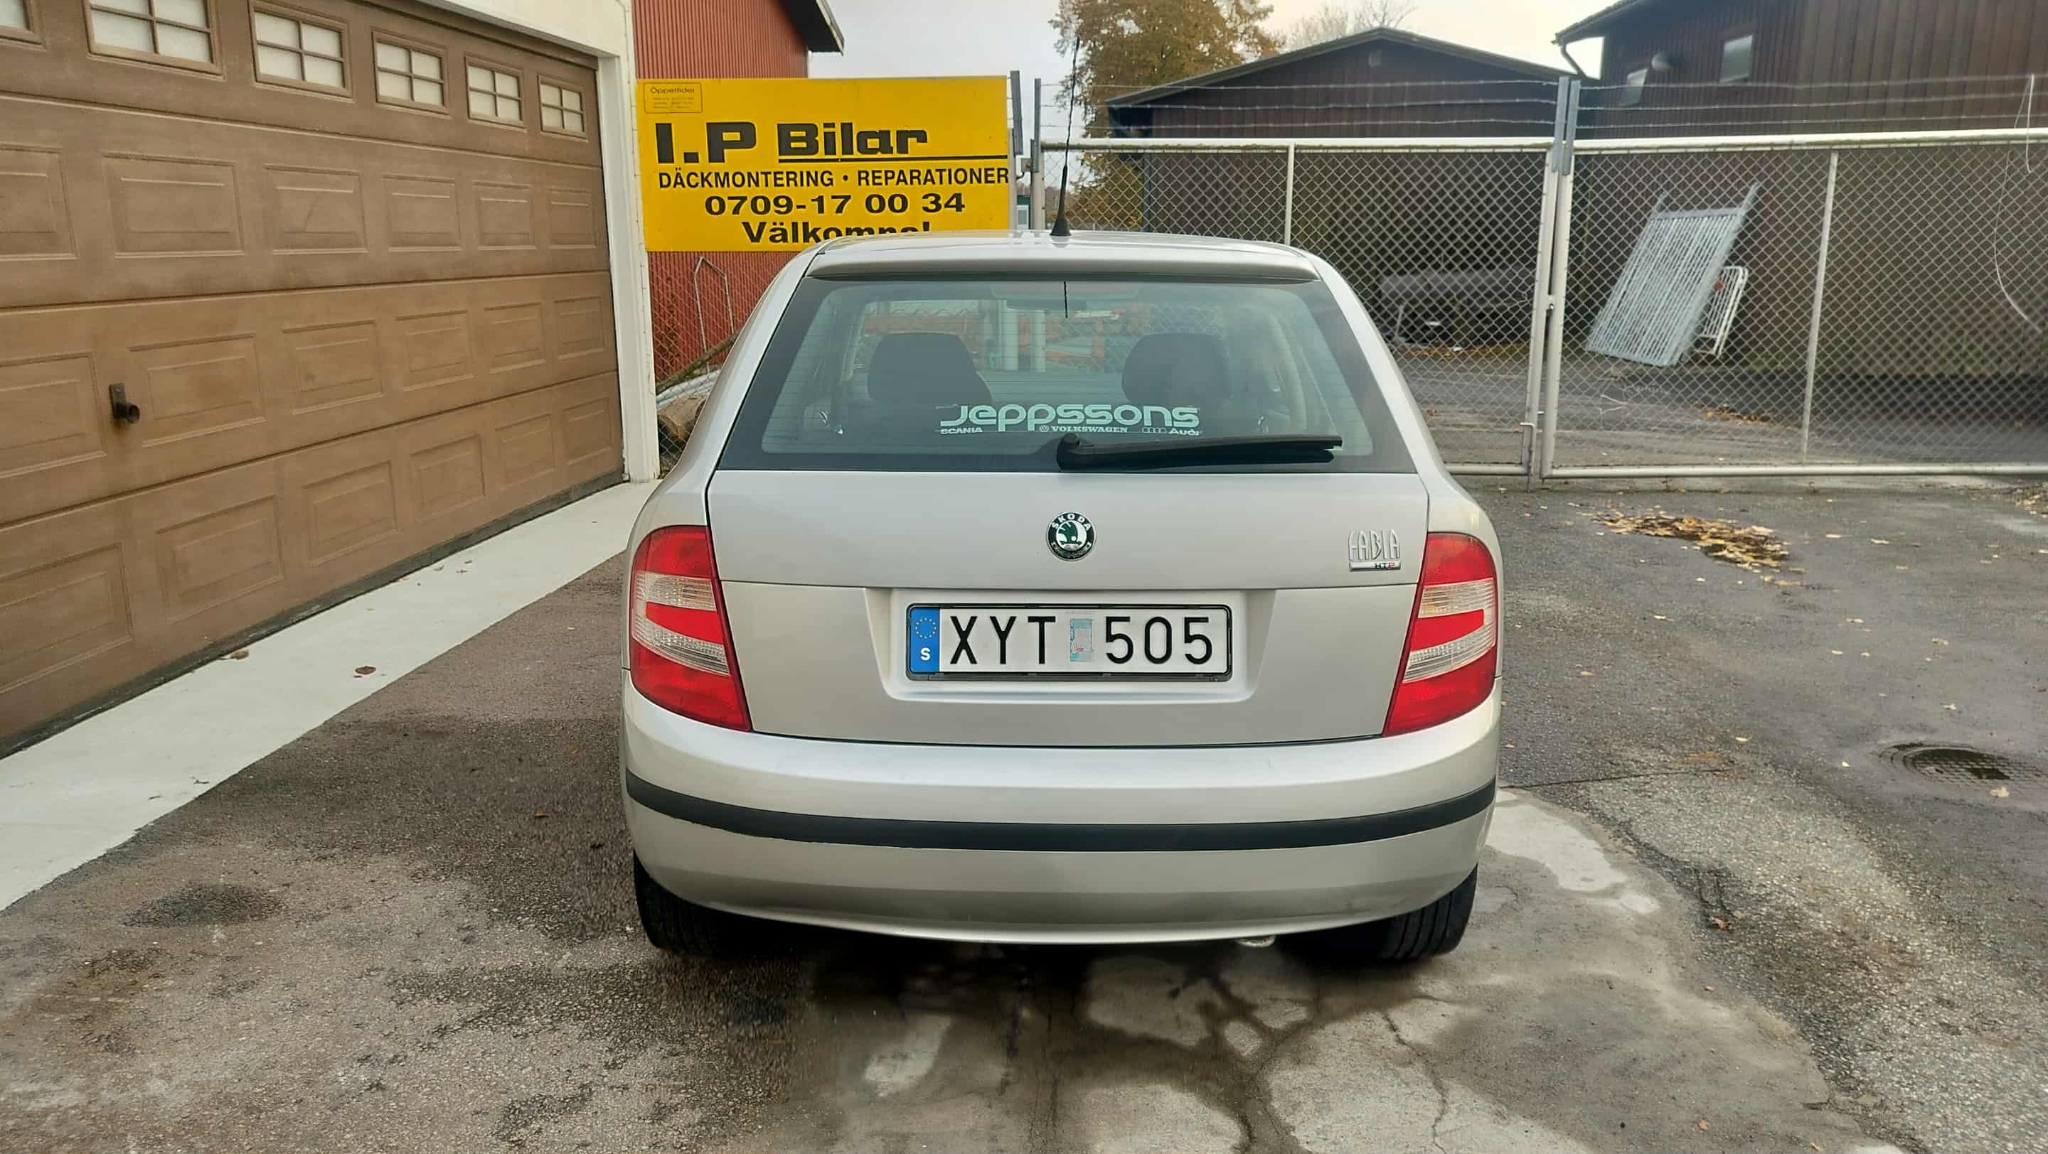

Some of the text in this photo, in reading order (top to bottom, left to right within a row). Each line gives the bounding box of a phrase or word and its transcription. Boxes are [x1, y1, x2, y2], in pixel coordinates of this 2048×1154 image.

[655, 122, 927, 164] I.P Bilar
[658, 167, 1009, 189] DÄCKMONTERING REPARATIONER
[705, 192, 965, 216] 0709-17 00 34
[940, 427, 983, 435] SCANIA
[1051, 425, 1128, 433] VOLKSWAGEN
[1168, 427, 1200, 436] Audi
[1347, 529, 1400, 561] FABIA
[1375, 562, 1396, 570] HTP
[920, 616, 1213, 664] S XYT 505
